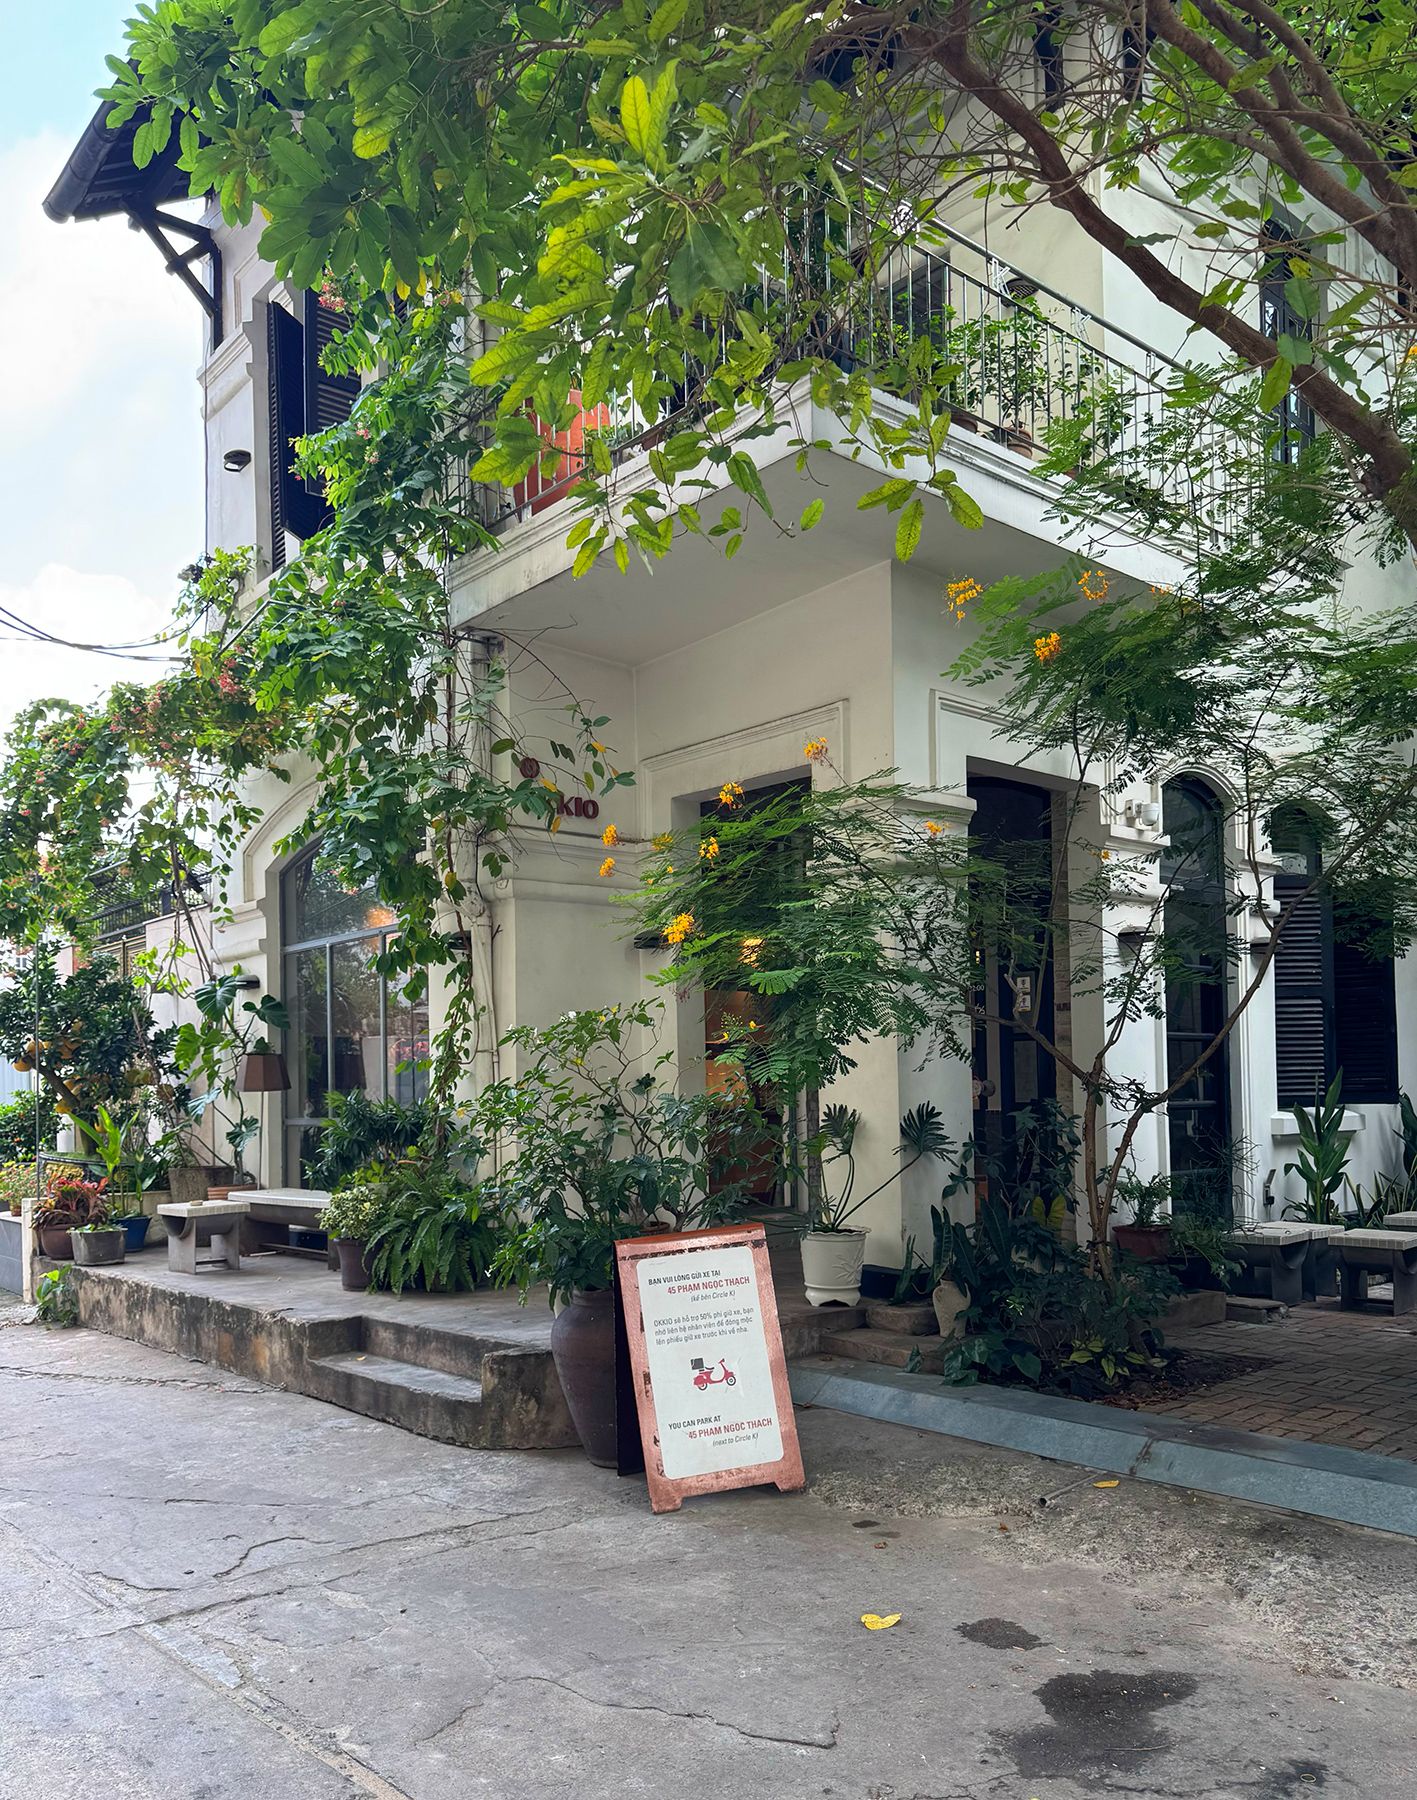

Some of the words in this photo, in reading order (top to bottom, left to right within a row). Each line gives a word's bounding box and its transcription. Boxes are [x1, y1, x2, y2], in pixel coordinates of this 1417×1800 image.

[648, 1278, 662, 1286] BẠN
[711, 1270, 720, 1278] TẠI
[668, 1286, 677, 1294] 45
[677, 1283, 700, 1293] PHẠM
[702, 1280, 723, 1290] NGỌC
[724, 1276, 750, 1287] THẠCH
[712, 1291, 728, 1299] Circle
[654, 1317, 673, 1327] OKKIO
[700, 1312, 712, 1321] 50%
[668, 1421, 682, 1430] YOU
[682, 1419, 696, 1428] CAN
[697, 1416, 713, 1425] PARK
[713, 1415, 721, 1423] AT
[689, 1430, 698, 1439] 45
[698, 1426, 722, 1438] PHAM
[723, 1422, 746, 1434] NGOC
[746, 1417, 773, 1429] THACH
[713, 1438, 727, 1447] (next
[735, 1434, 751, 1443] Circle
[752, 1432, 759, 1440] K)
